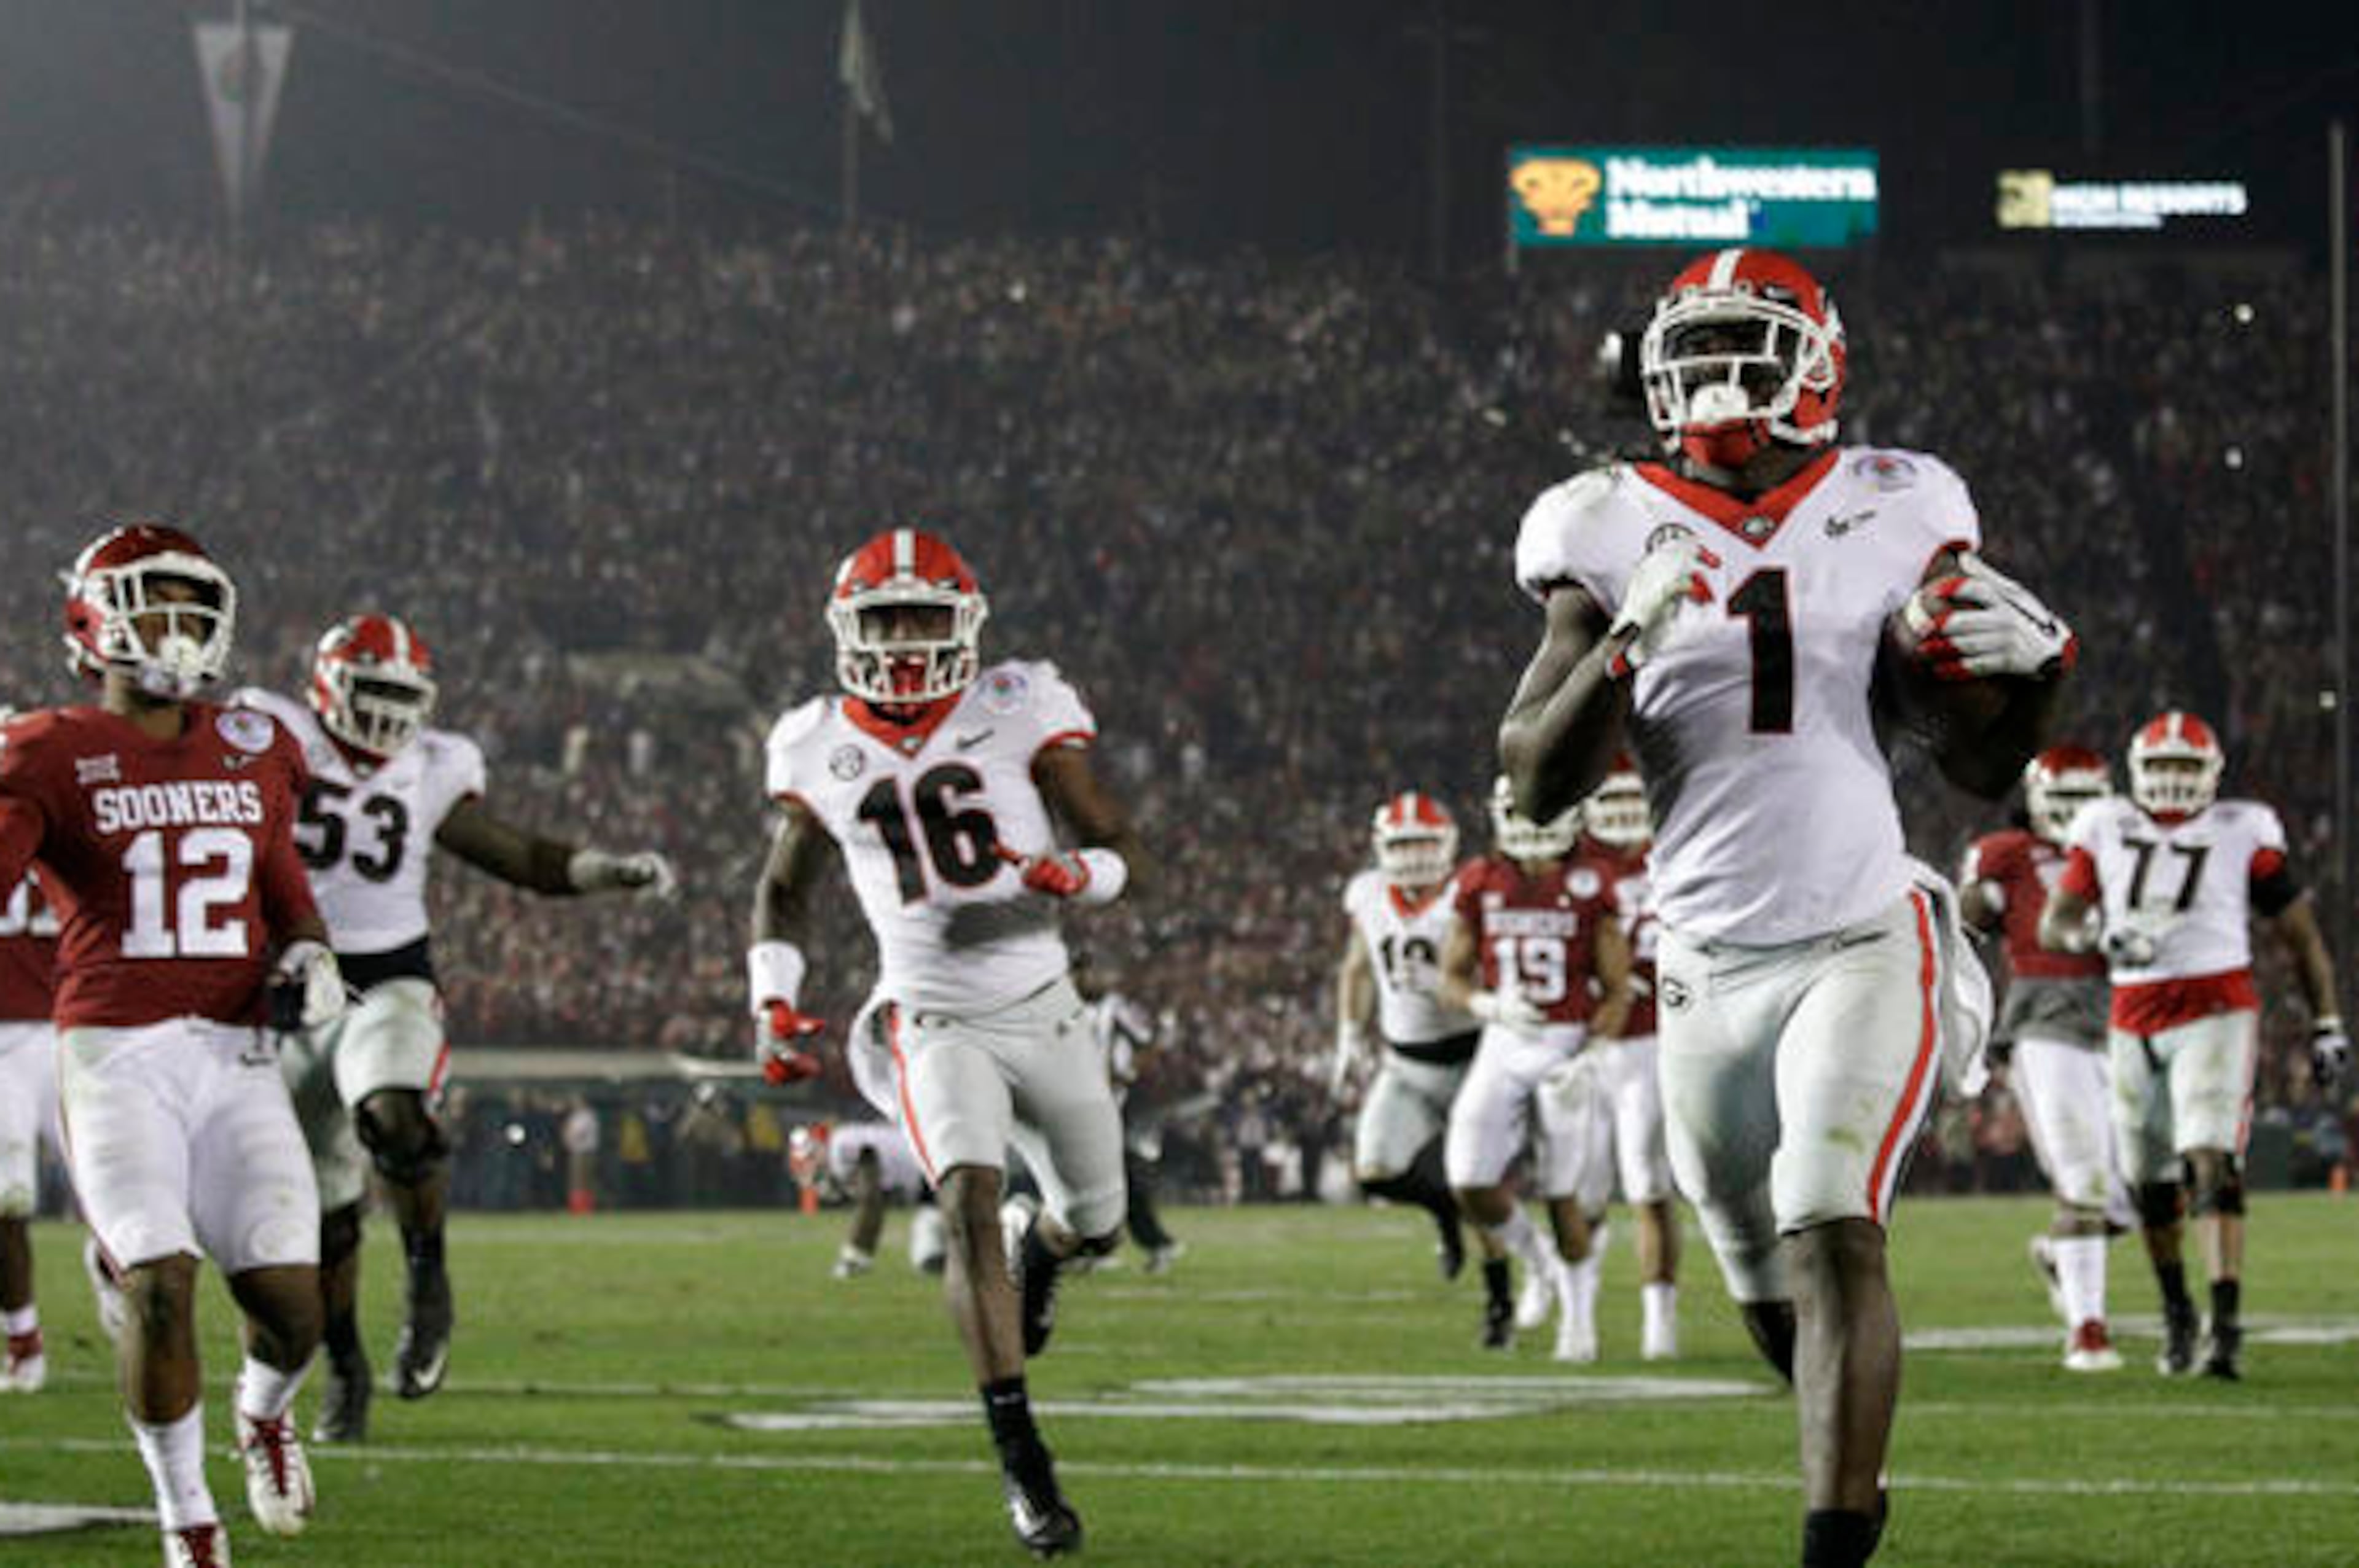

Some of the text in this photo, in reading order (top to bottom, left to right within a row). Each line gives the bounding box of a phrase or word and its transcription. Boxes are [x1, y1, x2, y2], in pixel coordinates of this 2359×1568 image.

[1606, 156, 1877, 200] Northwestern
[1606, 197, 1750, 239] Mutual
[1727, 566, 1793, 735] 1
[94, 781, 263, 832] SOONERS
[295, 776, 409, 883] 53
[858, 762, 1003, 905] 16
[122, 827, 253, 958] 12
[2122, 838, 2211, 913] 77
[1492, 935, 1568, 1005] 19
